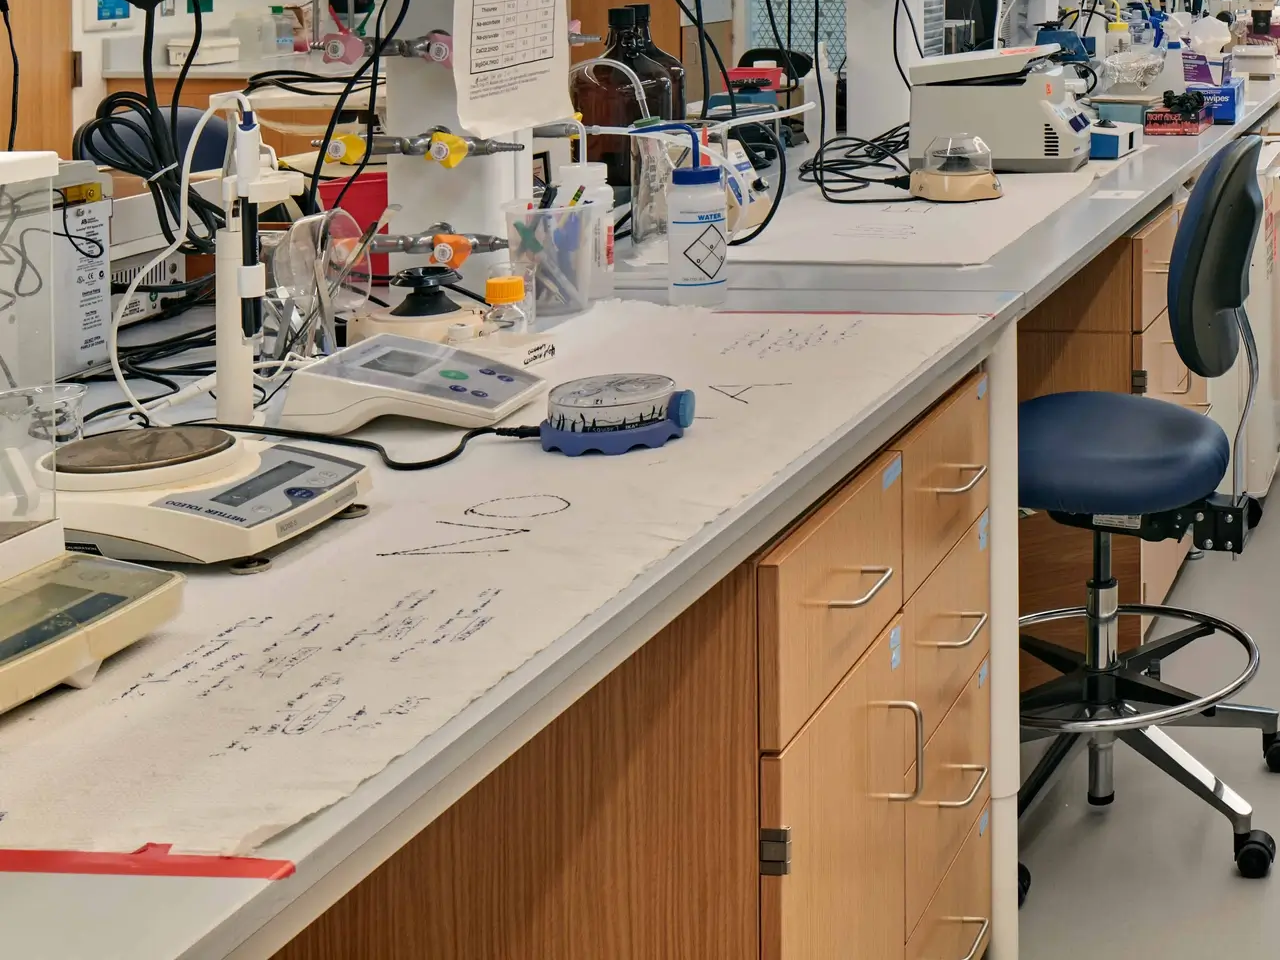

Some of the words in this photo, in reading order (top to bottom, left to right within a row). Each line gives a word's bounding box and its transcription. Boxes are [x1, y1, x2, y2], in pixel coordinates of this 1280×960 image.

[1147, 113, 1163, 121] NIGHT
[698, 213, 722, 221] WATER
[165, 499, 203, 513] TOLEDO
[205, 508, 247, 523] METTLER
